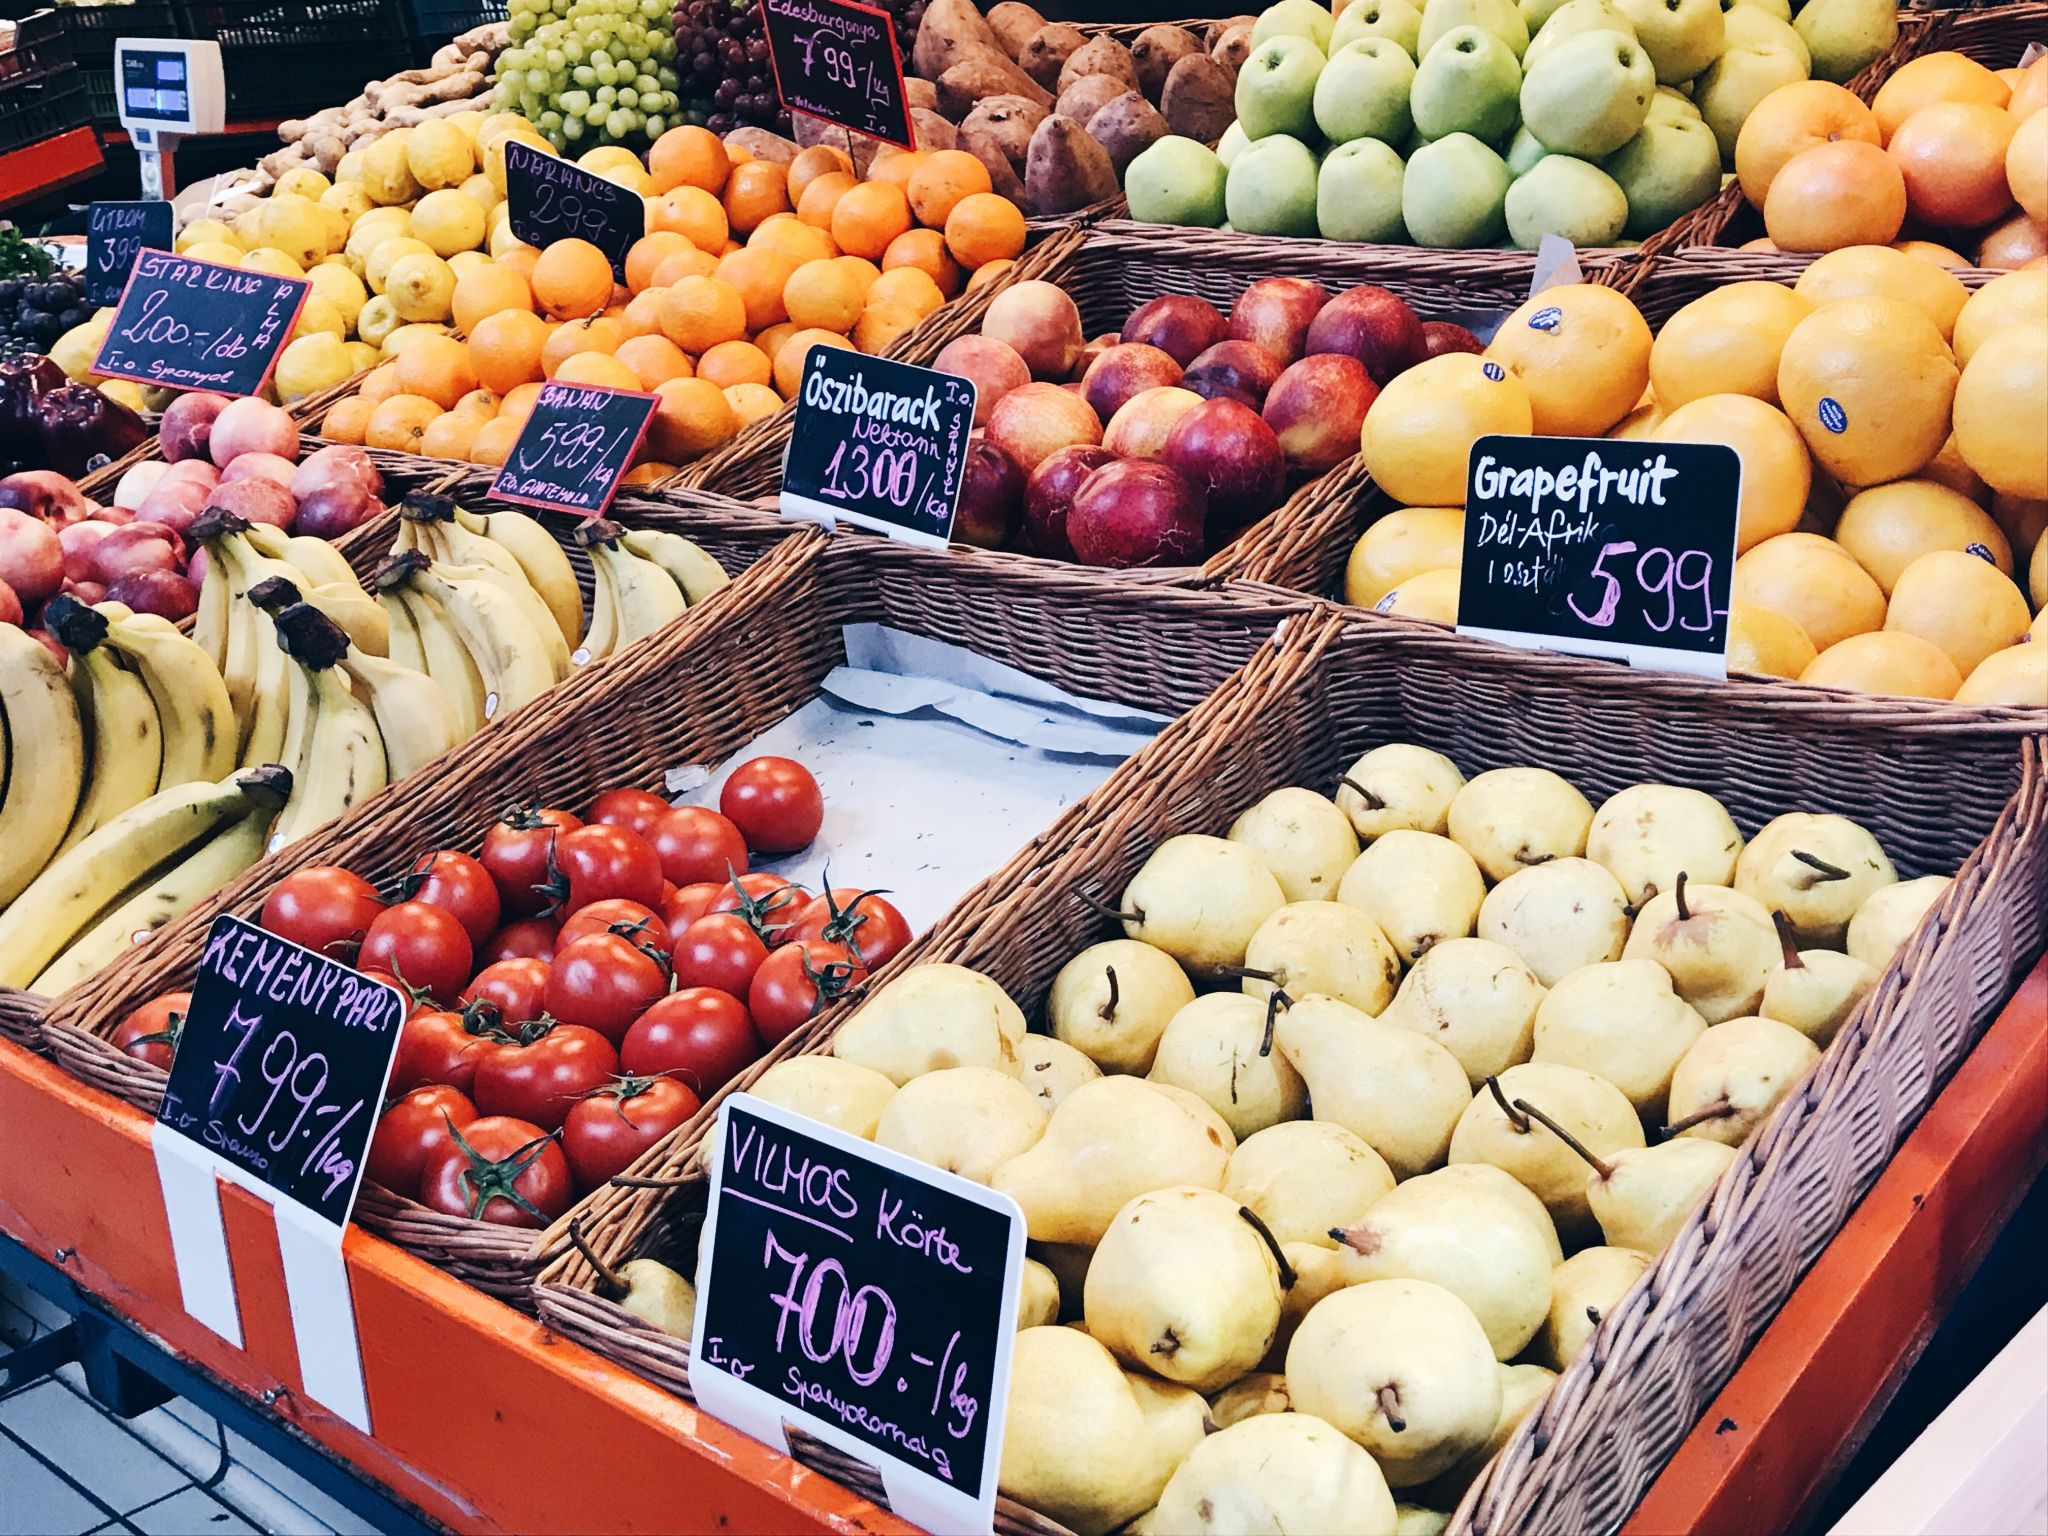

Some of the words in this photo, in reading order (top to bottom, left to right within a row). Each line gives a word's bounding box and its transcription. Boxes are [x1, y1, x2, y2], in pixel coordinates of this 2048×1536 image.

[137, 257, 263, 295] STARKING
[805, 354, 942, 431] Őszibarack
[1474, 451, 1680, 514] Grapefruit
[732, 1121, 858, 1219] VILMOS
[877, 1187, 972, 1274] Körte
